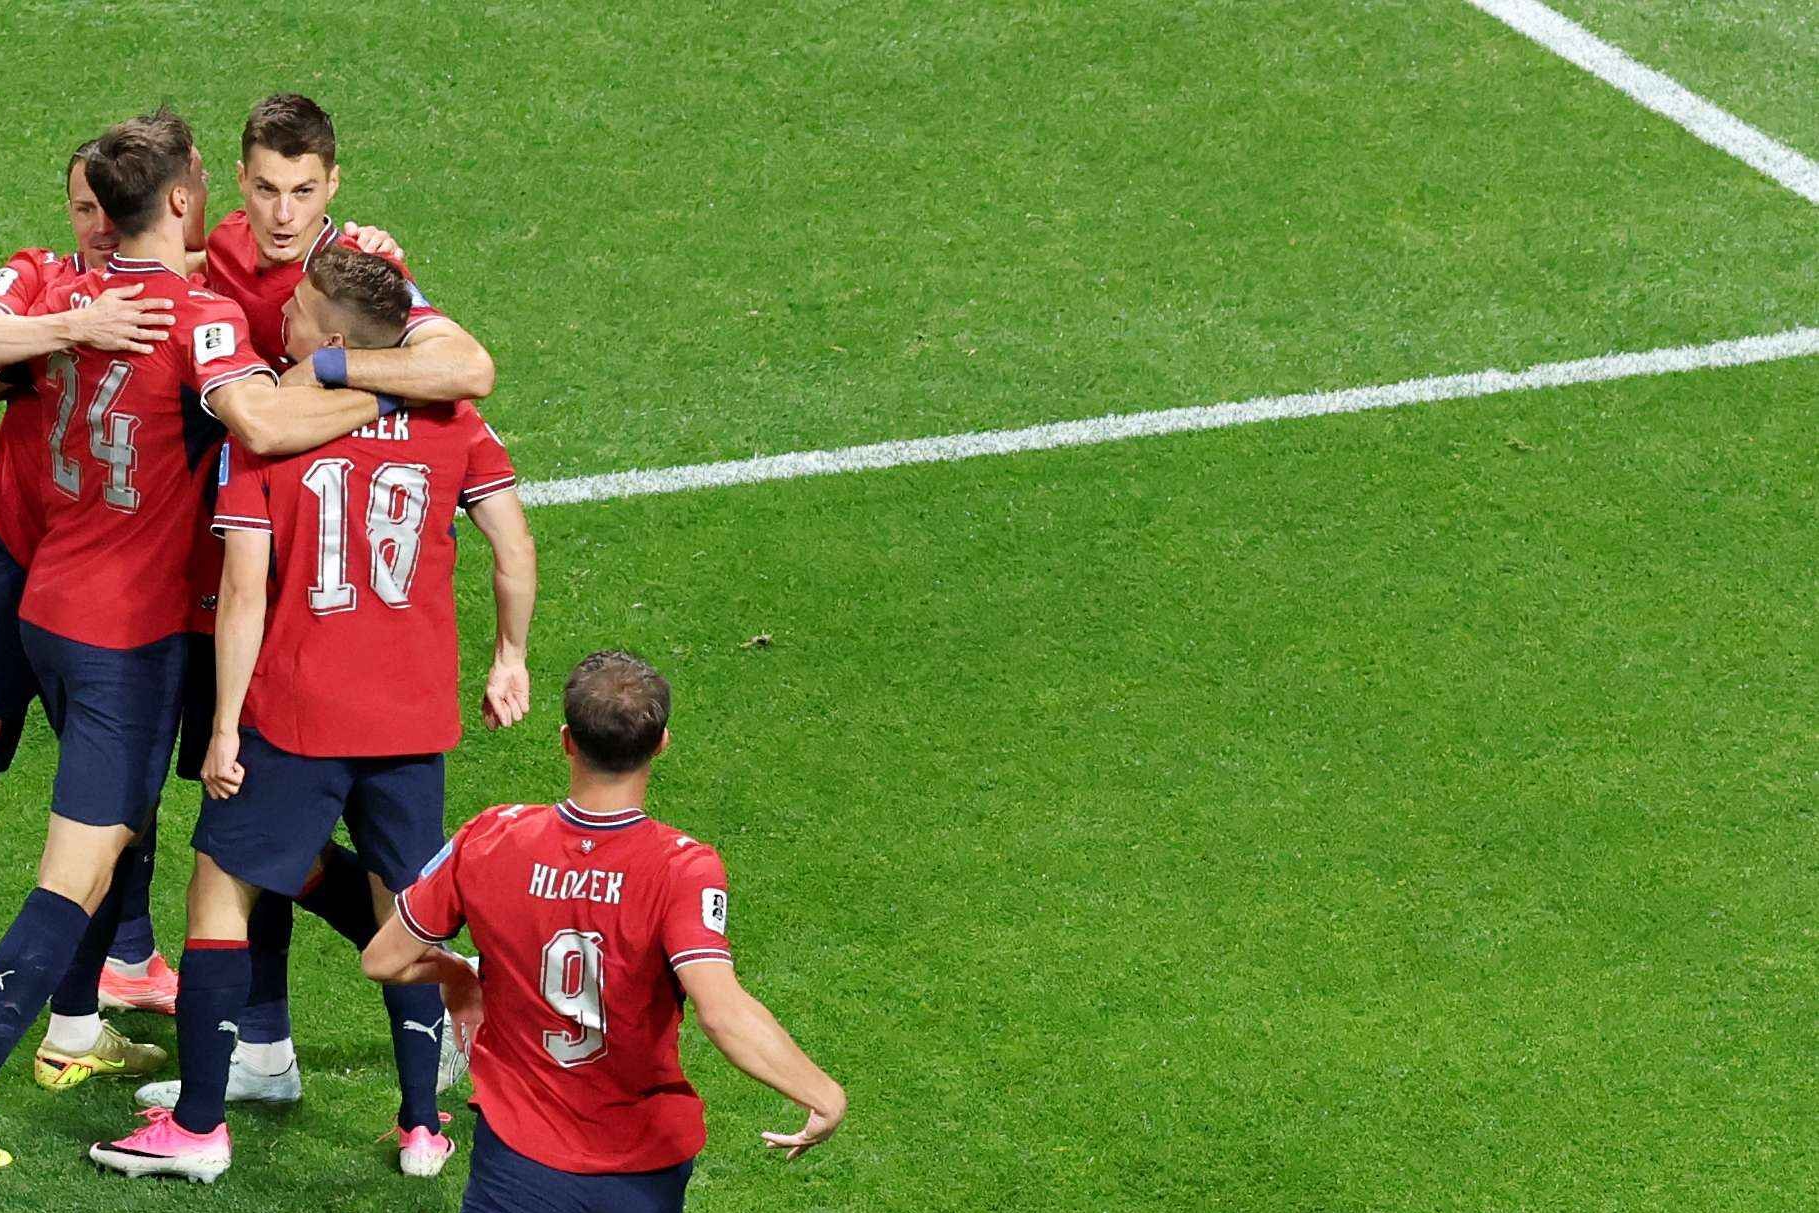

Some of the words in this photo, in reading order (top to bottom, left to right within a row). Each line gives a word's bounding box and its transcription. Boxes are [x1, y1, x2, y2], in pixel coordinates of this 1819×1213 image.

[46, 349, 142, 514] 24
[302, 457, 431, 616] 18
[540, 928, 608, 1069] 9
